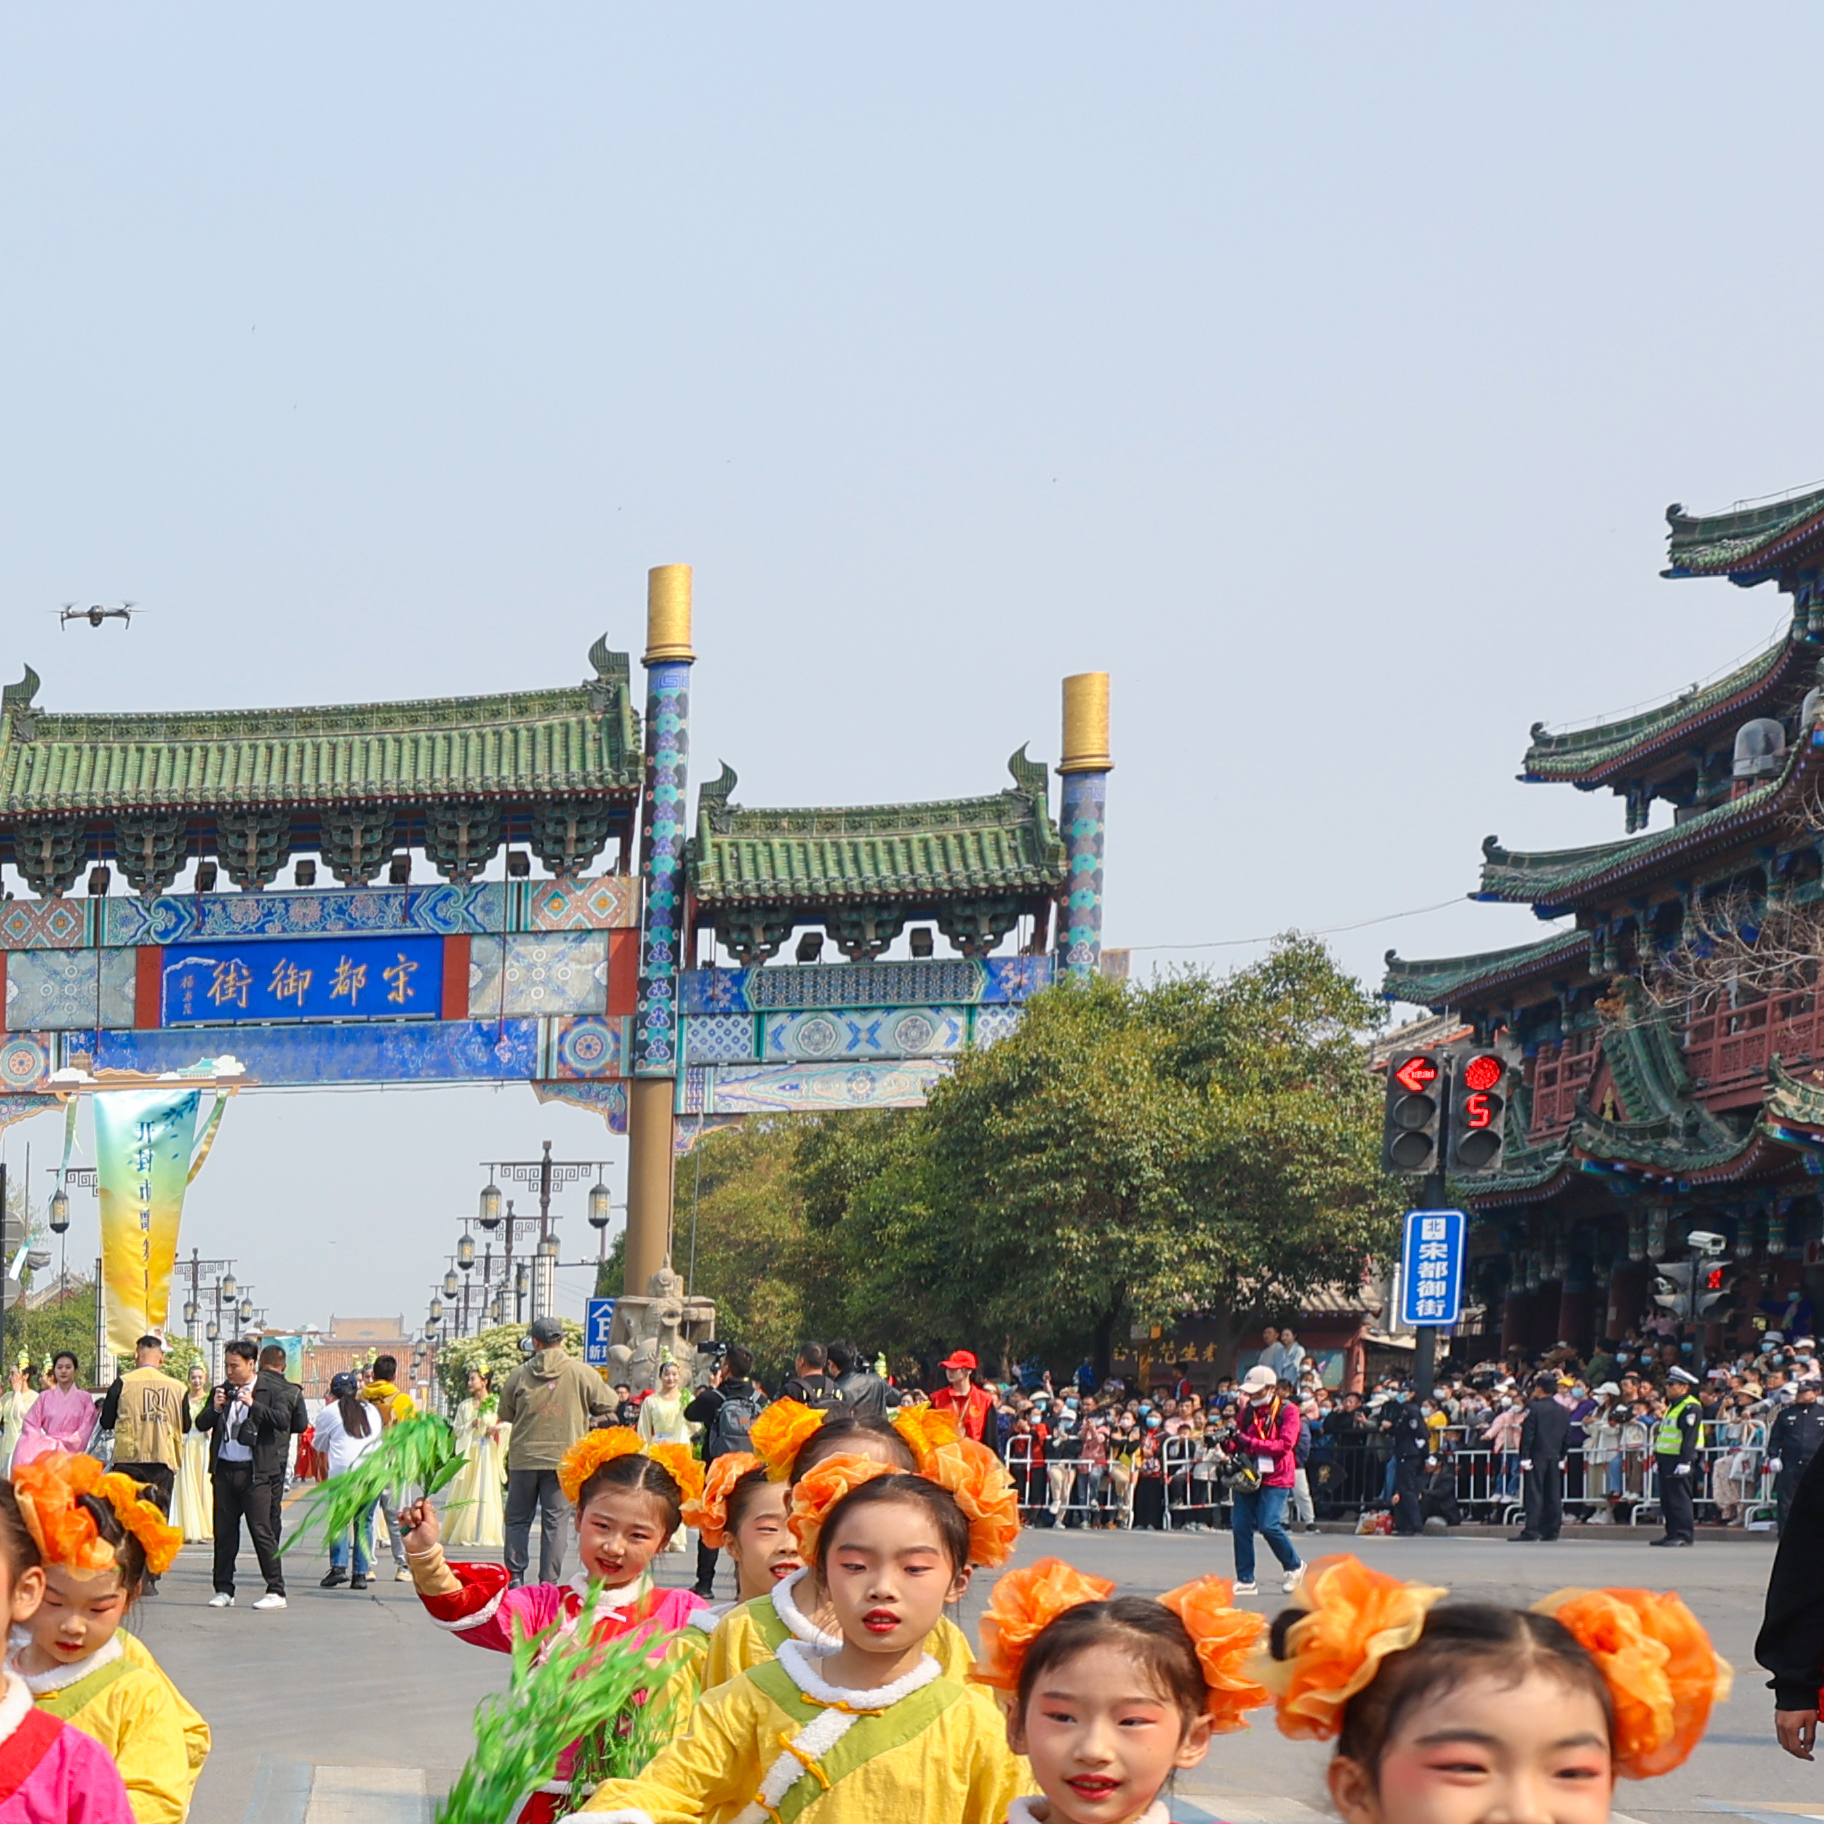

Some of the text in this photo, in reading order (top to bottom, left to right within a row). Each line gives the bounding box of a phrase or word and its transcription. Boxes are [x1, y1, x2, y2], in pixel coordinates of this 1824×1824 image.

[207, 953, 420, 1009] 宋都御街
[1466, 1094, 1491, 1128] 5
[1429, 1219, 1441, 1232] 北
[1416, 1242, 1448, 1318] 宋都御街
